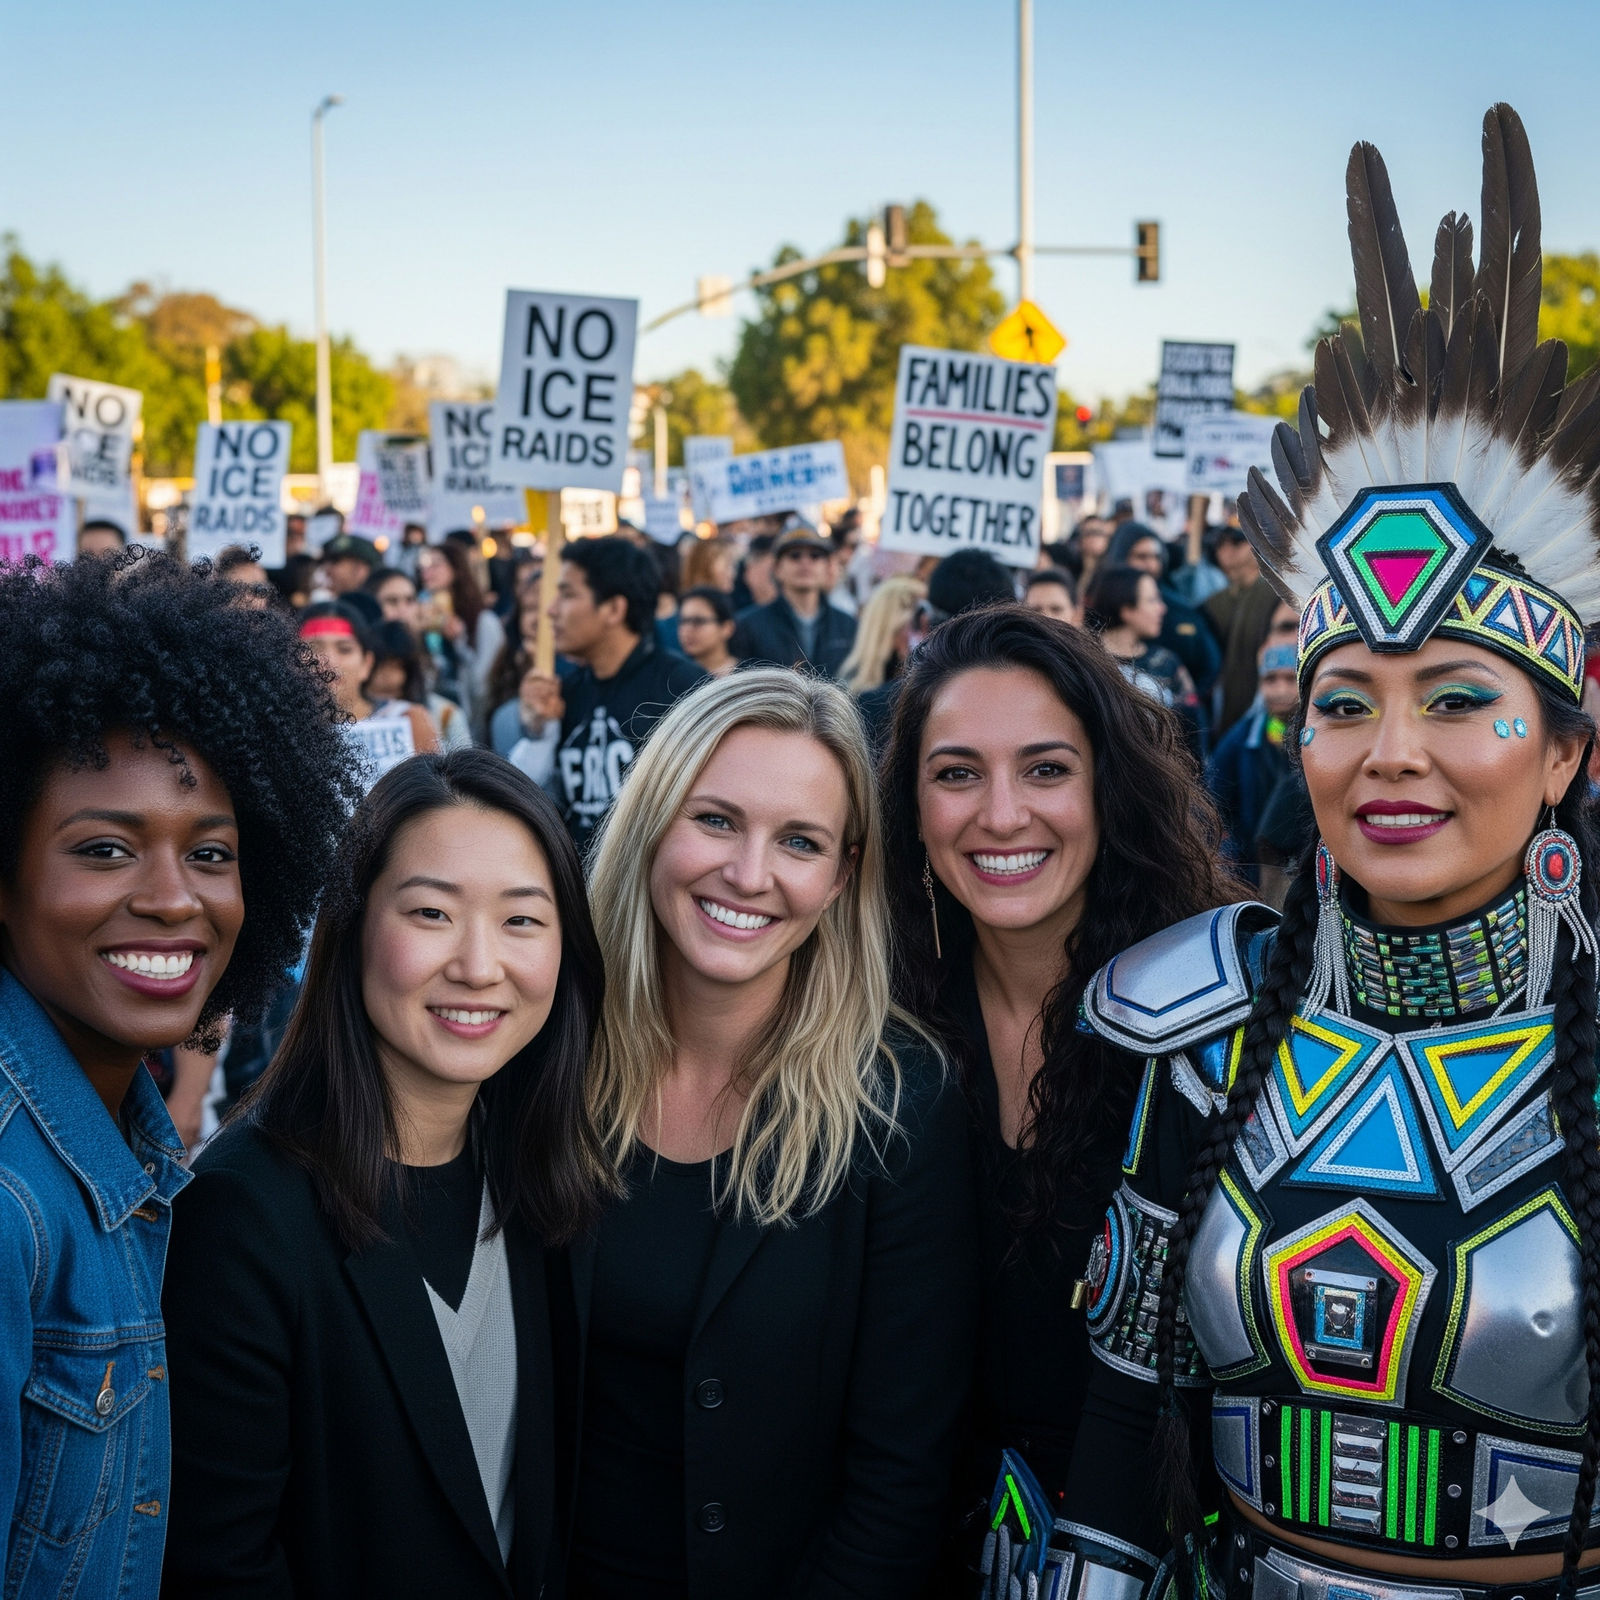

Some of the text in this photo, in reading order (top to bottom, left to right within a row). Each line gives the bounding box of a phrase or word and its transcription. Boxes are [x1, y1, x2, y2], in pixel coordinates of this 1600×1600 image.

[525, 304, 615, 362] NO
[64, 386, 125, 427] NO
[521, 367, 617, 423] ICE
[905, 357, 1050, 418] FAMILIES
[214, 425, 280, 462] NO
[502, 426, 613, 467] RAIDS
[902, 421, 1036, 479] BELONG
[208, 464, 273, 498] ICE
[195, 504, 277, 534] RAIDS
[892, 490, 1035, 547] TOGETHER
